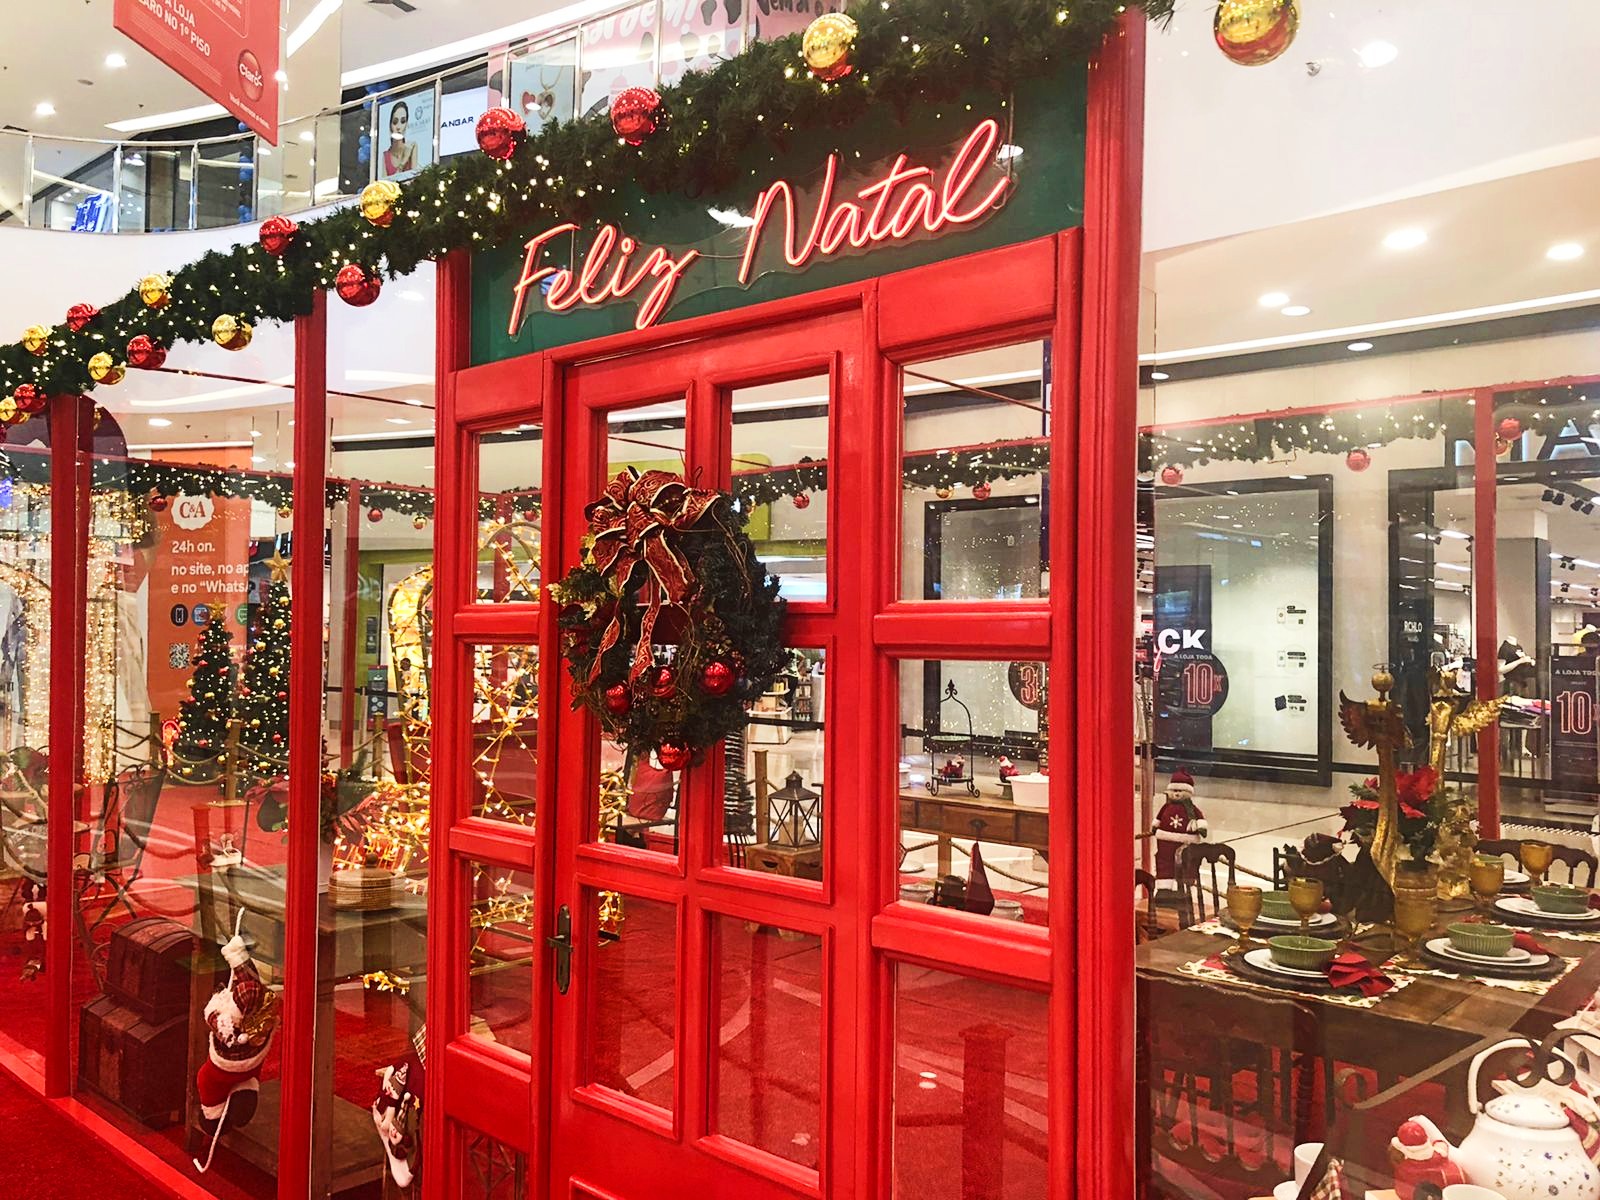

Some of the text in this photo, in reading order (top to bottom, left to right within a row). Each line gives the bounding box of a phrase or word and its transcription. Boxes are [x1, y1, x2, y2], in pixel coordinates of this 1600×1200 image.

[174, 0, 195, 27] LOJA
[164, 10, 178, 30] NO
[190, 31, 210, 56] PISO
[239, 63, 263, 87] Claro
[507, 118, 1012, 336] Feliz Natal
[179, 501, 206, 519] C&A
[171, 540, 216, 554] 24h on.
[171, 566, 187, 577] no
[189, 562, 215, 577] site,
[217, 564, 234, 575] no
[171, 584, 179, 594] e
[181, 583, 197, 593] no
[1153, 628, 1206, 654] CK
